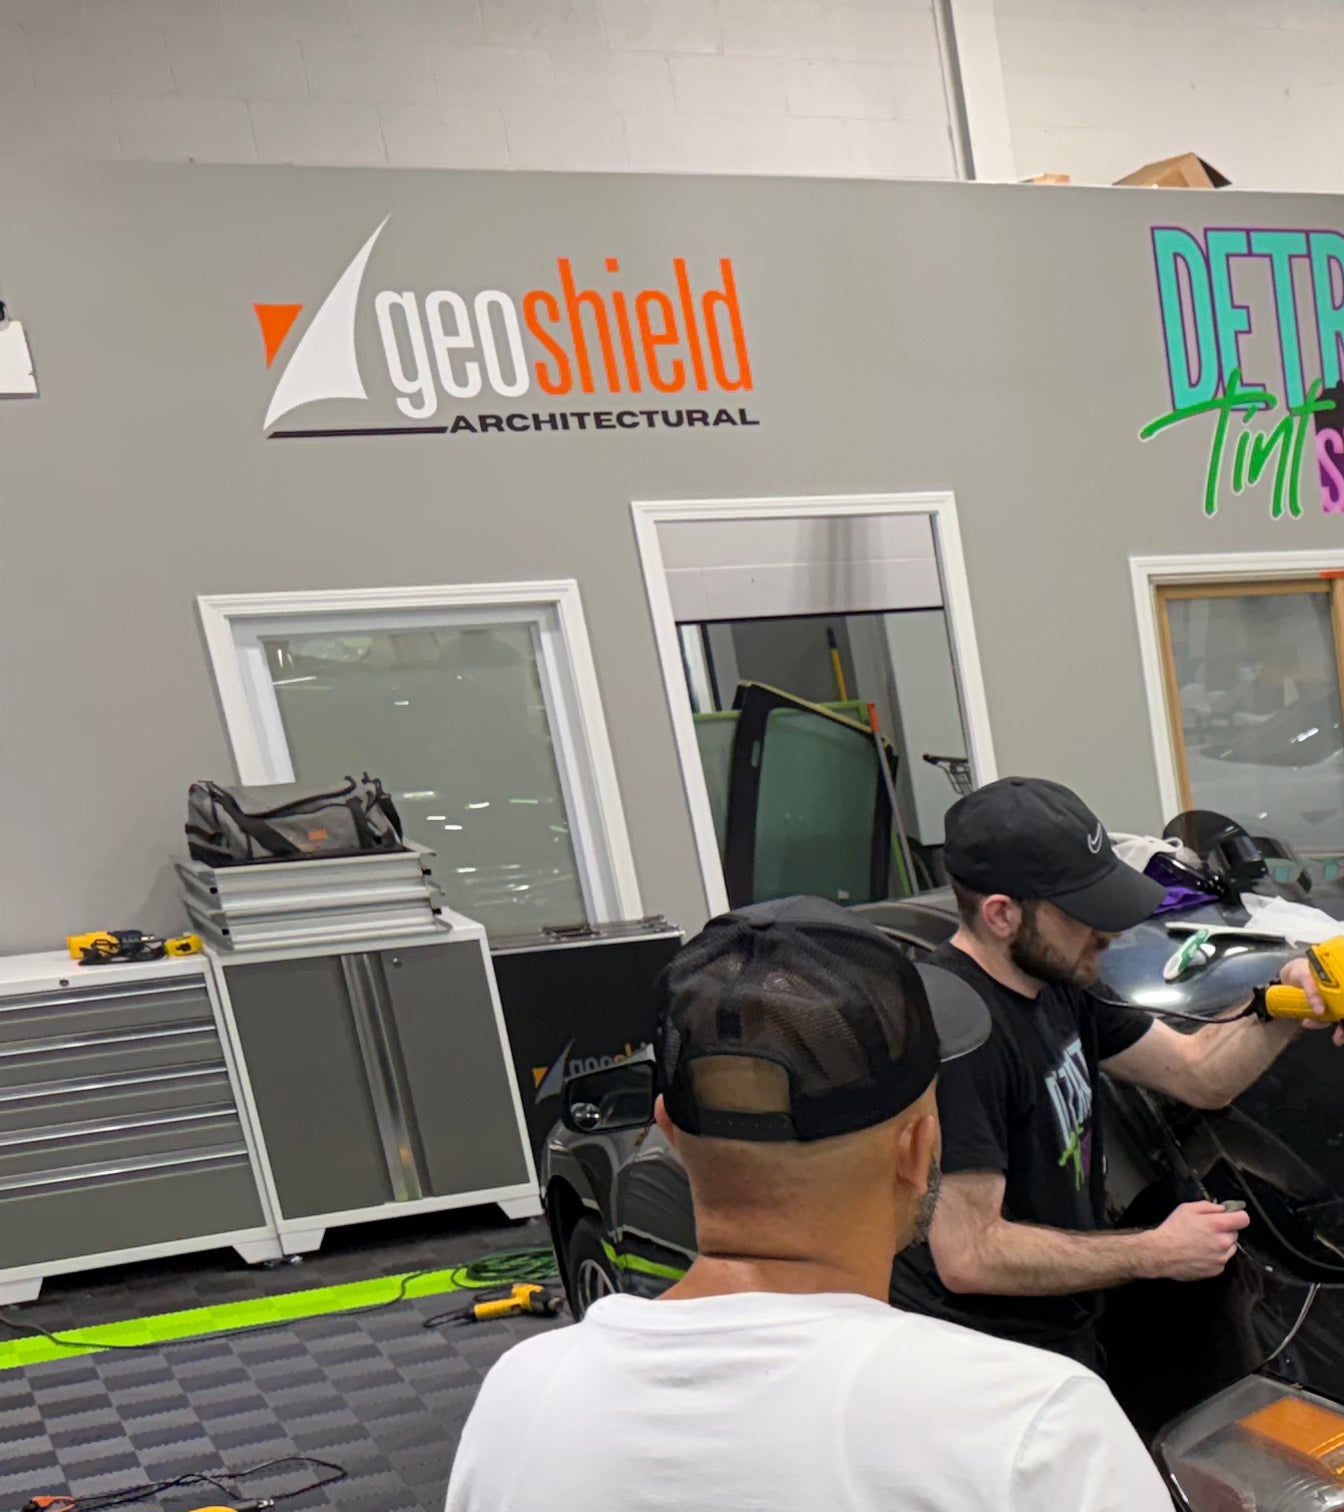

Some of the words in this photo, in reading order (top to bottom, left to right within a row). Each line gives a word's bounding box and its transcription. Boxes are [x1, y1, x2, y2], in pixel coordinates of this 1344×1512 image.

[374, 257, 753, 419] geoshield
[449, 408, 760, 434] ARCHITECTURAL
[1139, 366, 1336, 519] Tint
